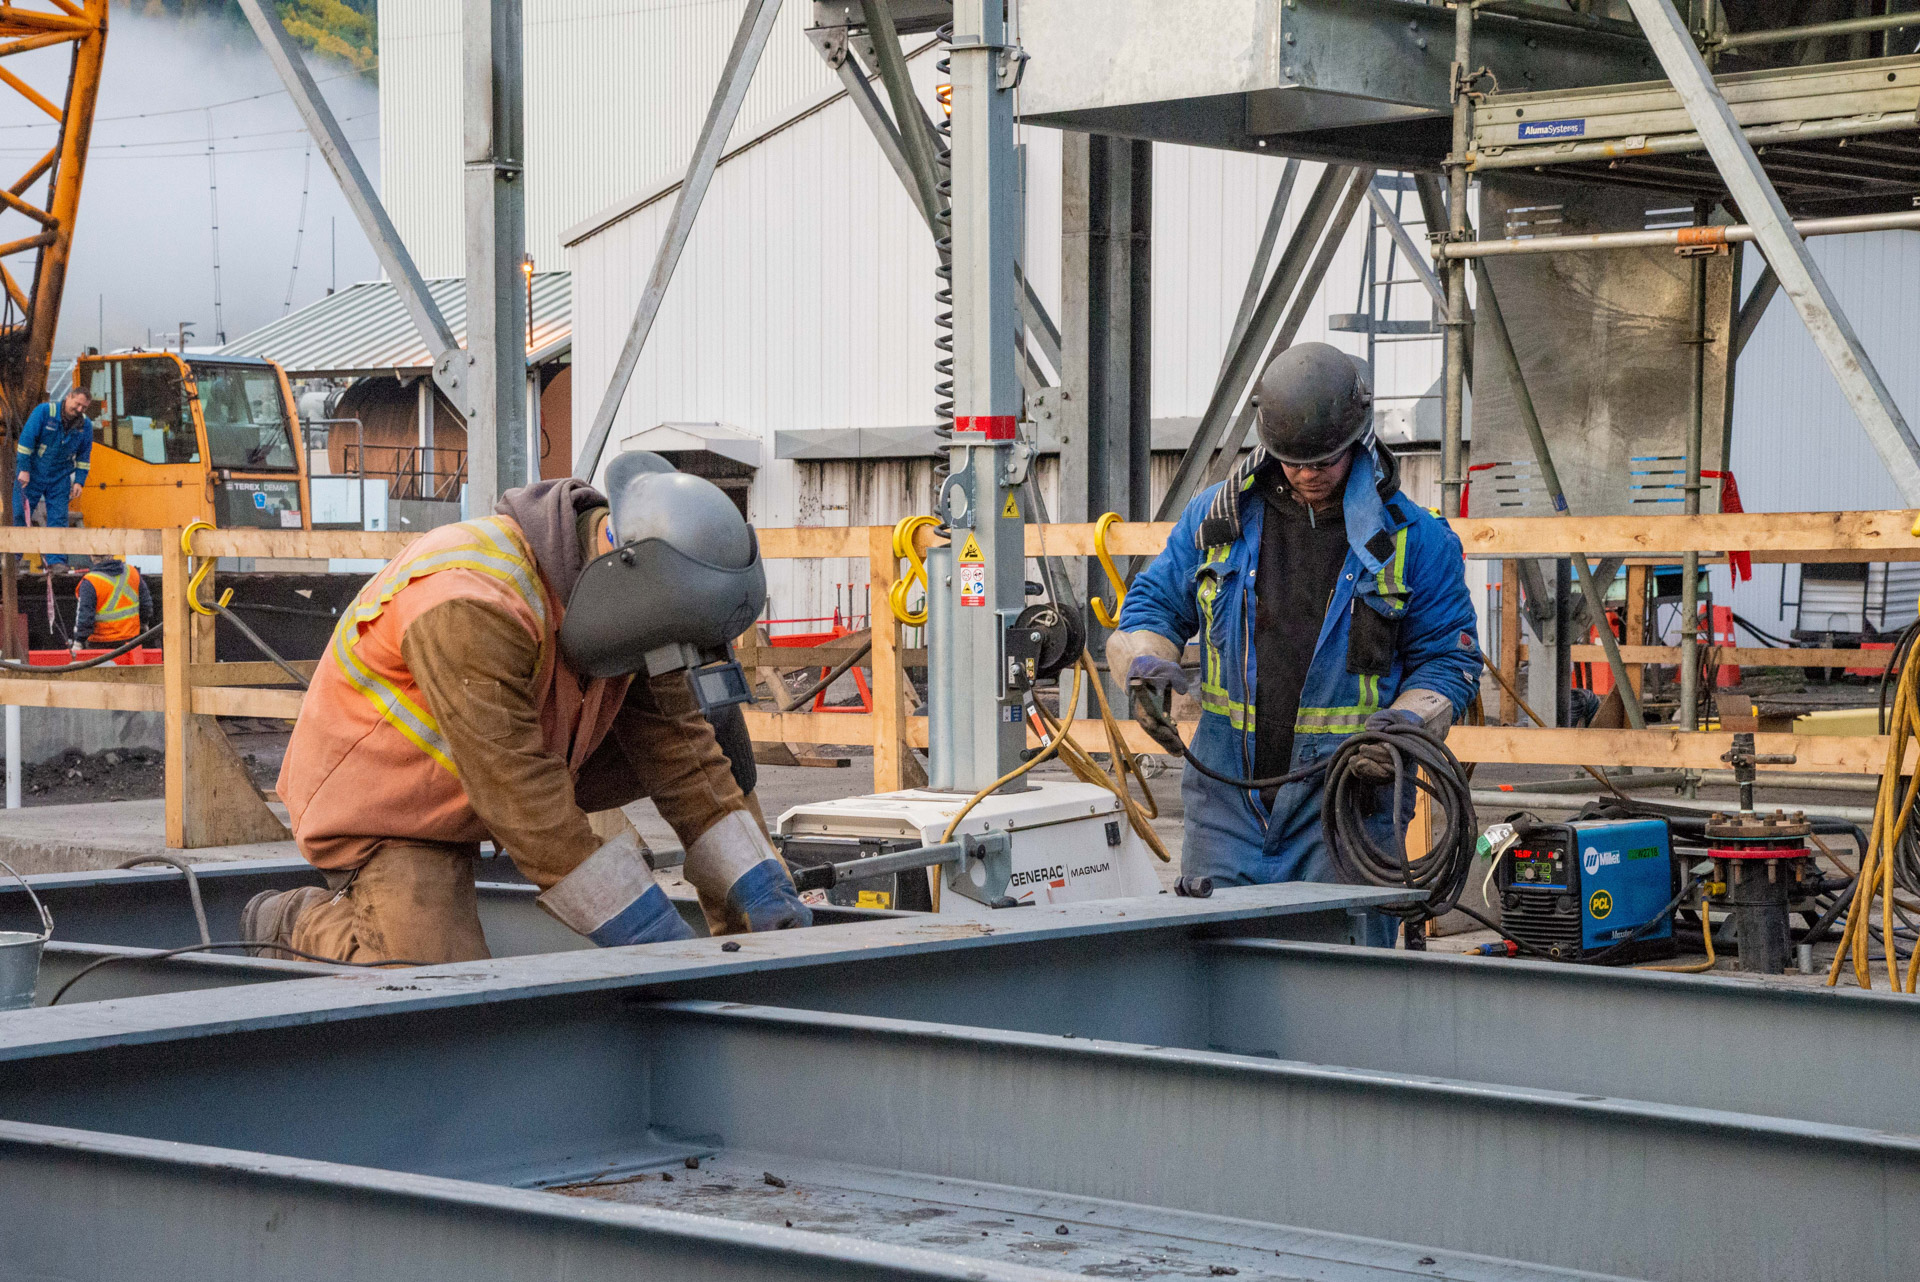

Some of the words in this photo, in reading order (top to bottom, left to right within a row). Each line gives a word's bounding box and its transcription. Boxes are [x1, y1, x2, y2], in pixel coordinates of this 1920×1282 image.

[234, 483, 260, 491] TEREX
[263, 484, 289, 492] DEMAG
[1599, 850, 1620, 866] Miller
[1010, 865, 1064, 887] GENERAC
[1070, 862, 1110, 878] MAGNUM
[1592, 897, 1610, 911] PCL
